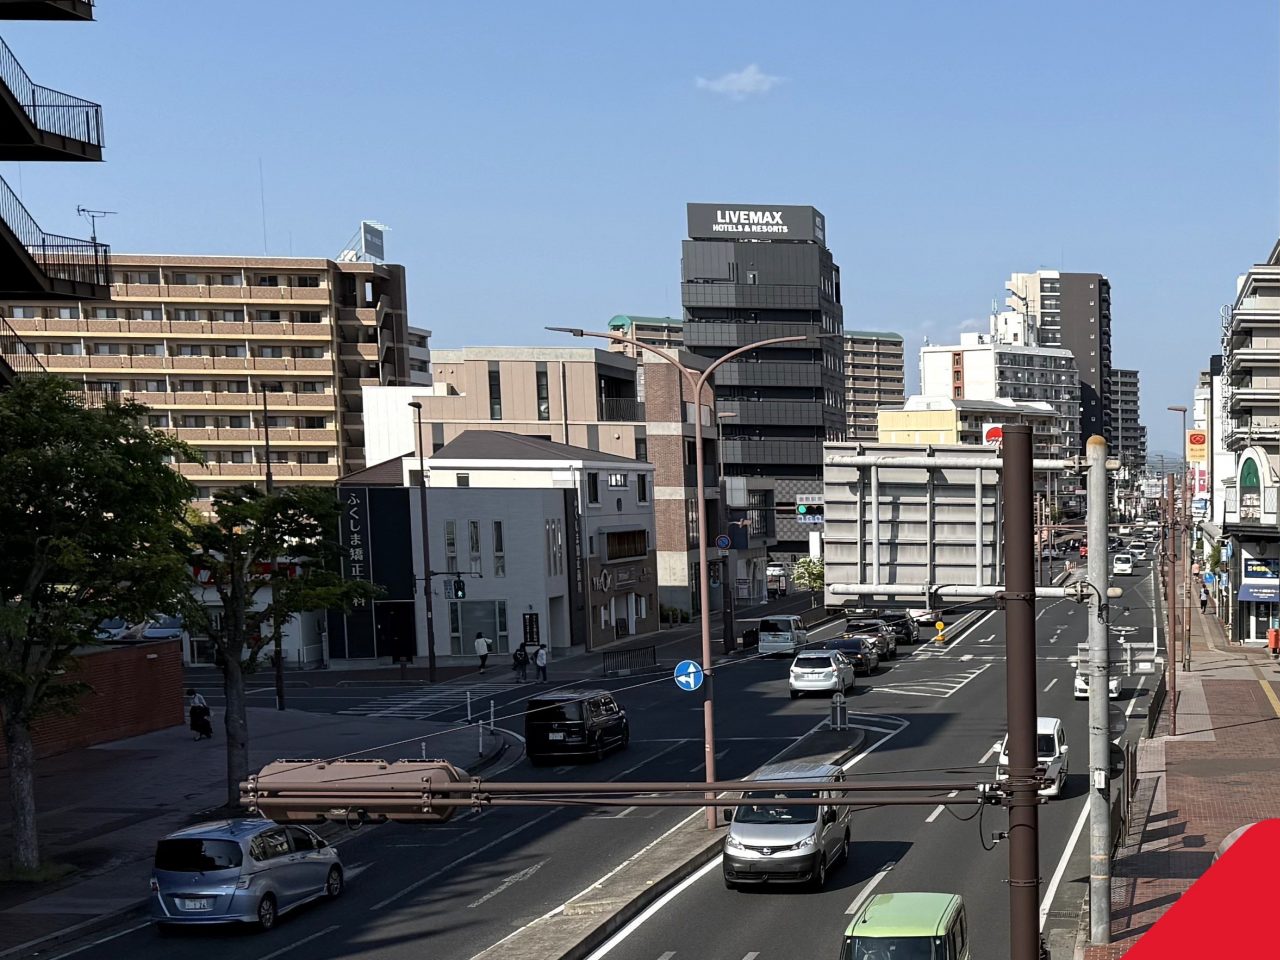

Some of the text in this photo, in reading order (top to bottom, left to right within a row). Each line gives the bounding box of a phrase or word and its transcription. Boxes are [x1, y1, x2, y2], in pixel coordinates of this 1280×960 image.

[717, 210, 783, 224] LIVEMAX
[347, 493, 365, 607] ふくしま矯正科
